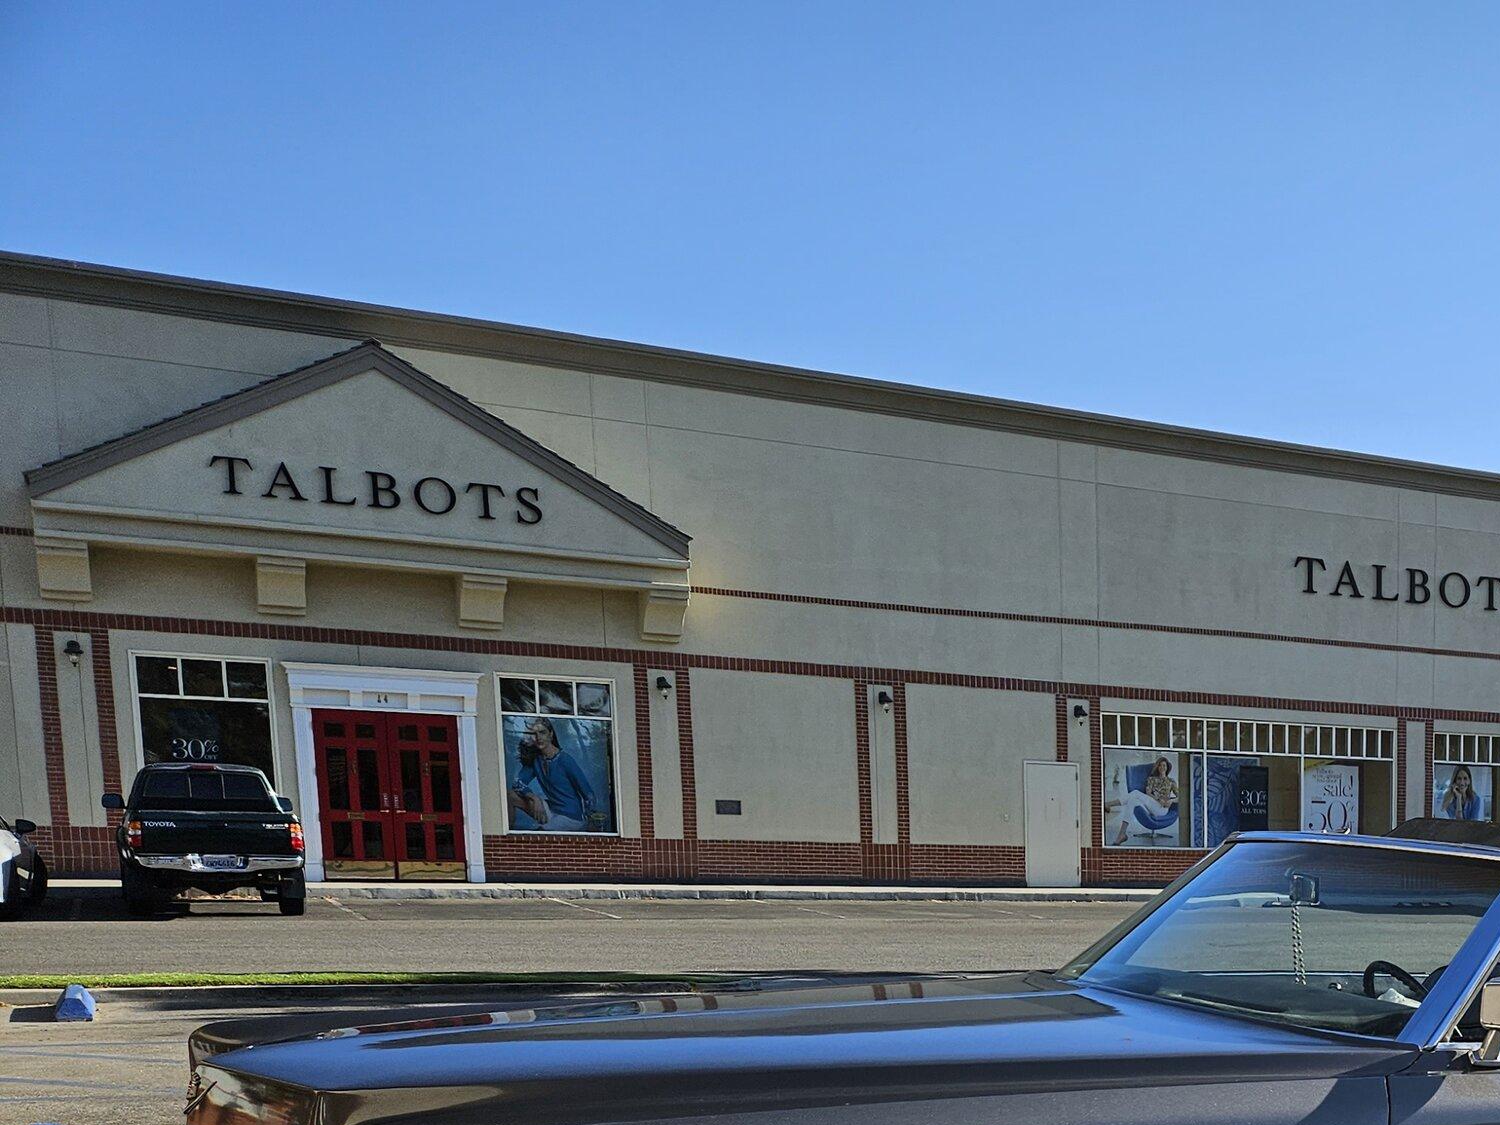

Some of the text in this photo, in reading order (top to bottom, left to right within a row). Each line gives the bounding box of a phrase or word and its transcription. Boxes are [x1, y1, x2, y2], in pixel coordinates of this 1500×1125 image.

[209, 455, 543, 525] TALBOTS
[172, 738, 219, 759] 30%
[1323, 773, 1354, 798] sale!
[143, 820, 177, 828] TOYOTA
